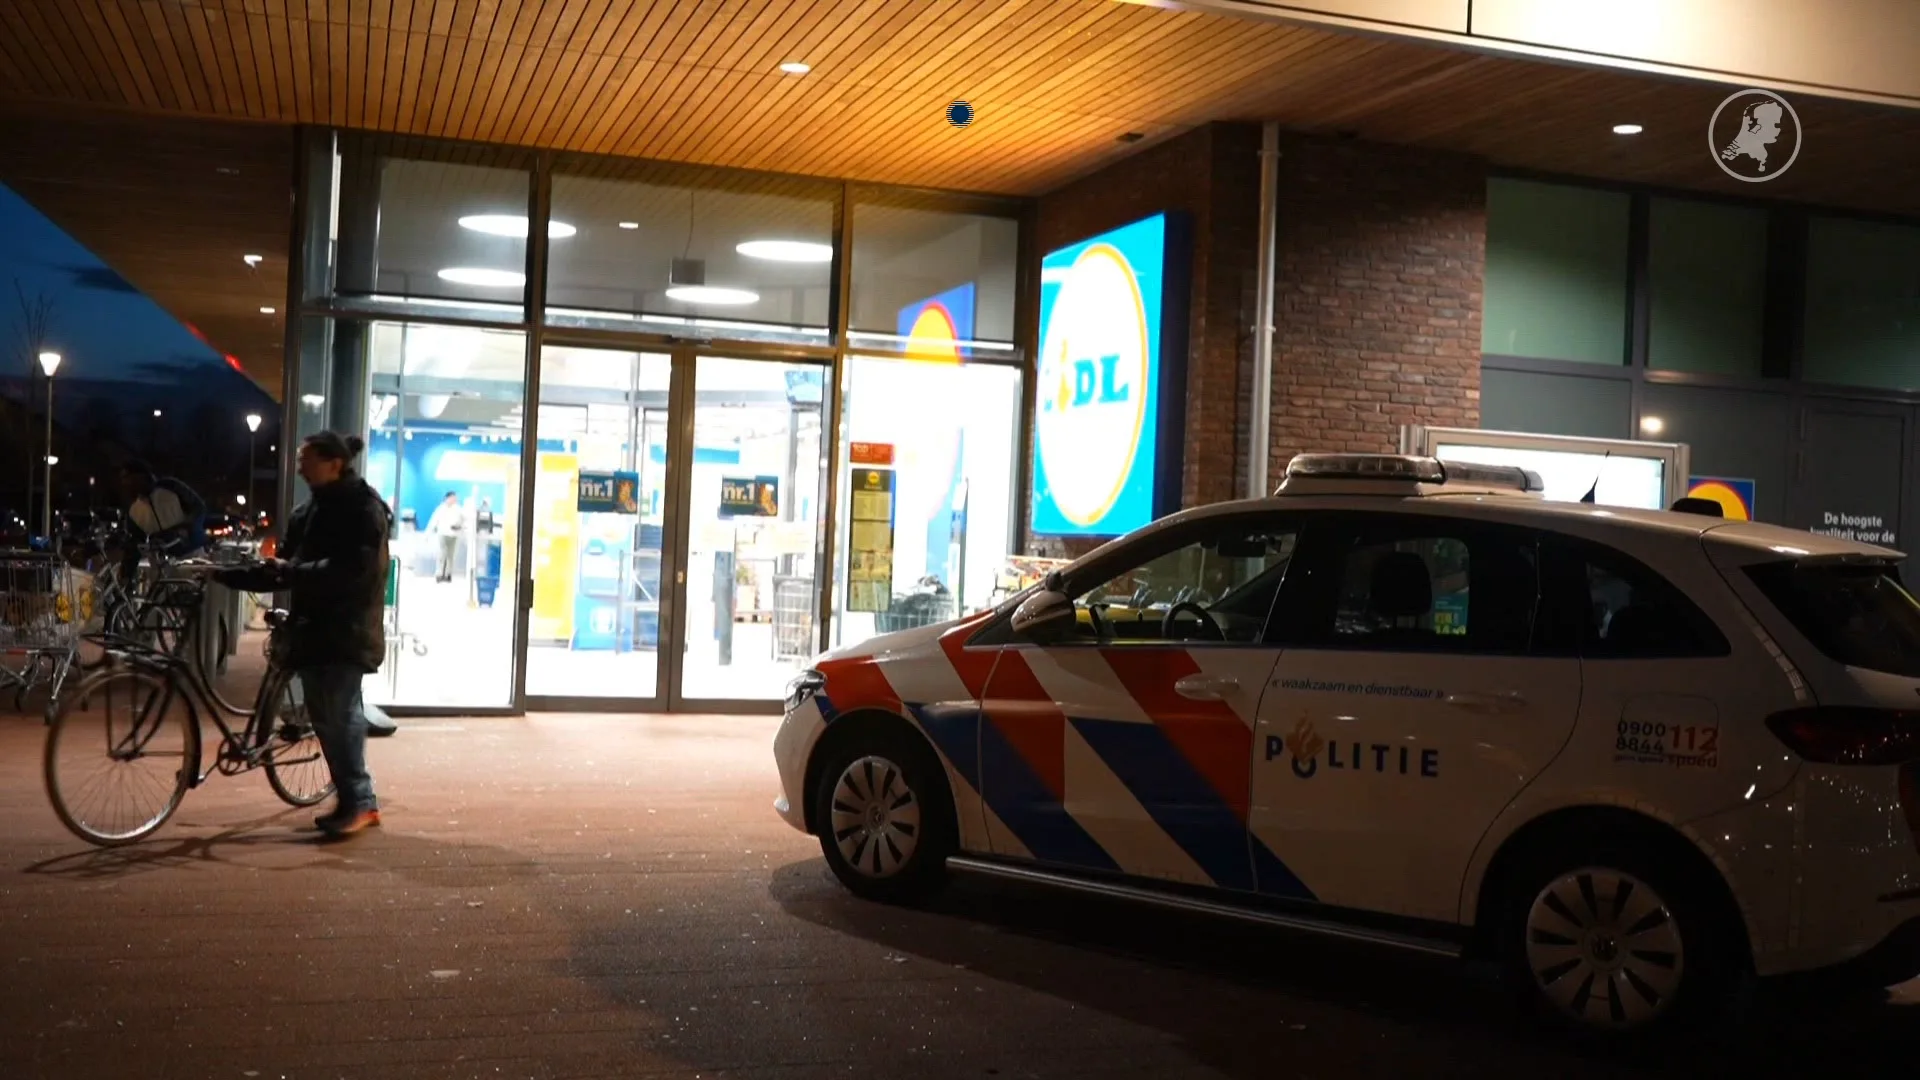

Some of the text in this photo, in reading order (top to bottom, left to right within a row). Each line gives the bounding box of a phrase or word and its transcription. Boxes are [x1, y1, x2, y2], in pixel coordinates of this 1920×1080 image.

[580, 479, 613, 497] nr.1
[723, 483, 755, 501] nr.1
[1824, 511, 1883, 528] De hoogste
[1856, 532, 1880, 542] voor
[1881, 530, 1896, 543] de
[1282, 678, 1346, 692] waakzaam
[1347, 684, 1364, 694] en
[1365, 683, 1434, 698] dienstbaar
[1617, 720, 1666, 737] 0900
[1616, 736, 1664, 754] 8844
[1669, 724, 1718, 752] 112
[1265, 735, 1439, 778] POLITIE
